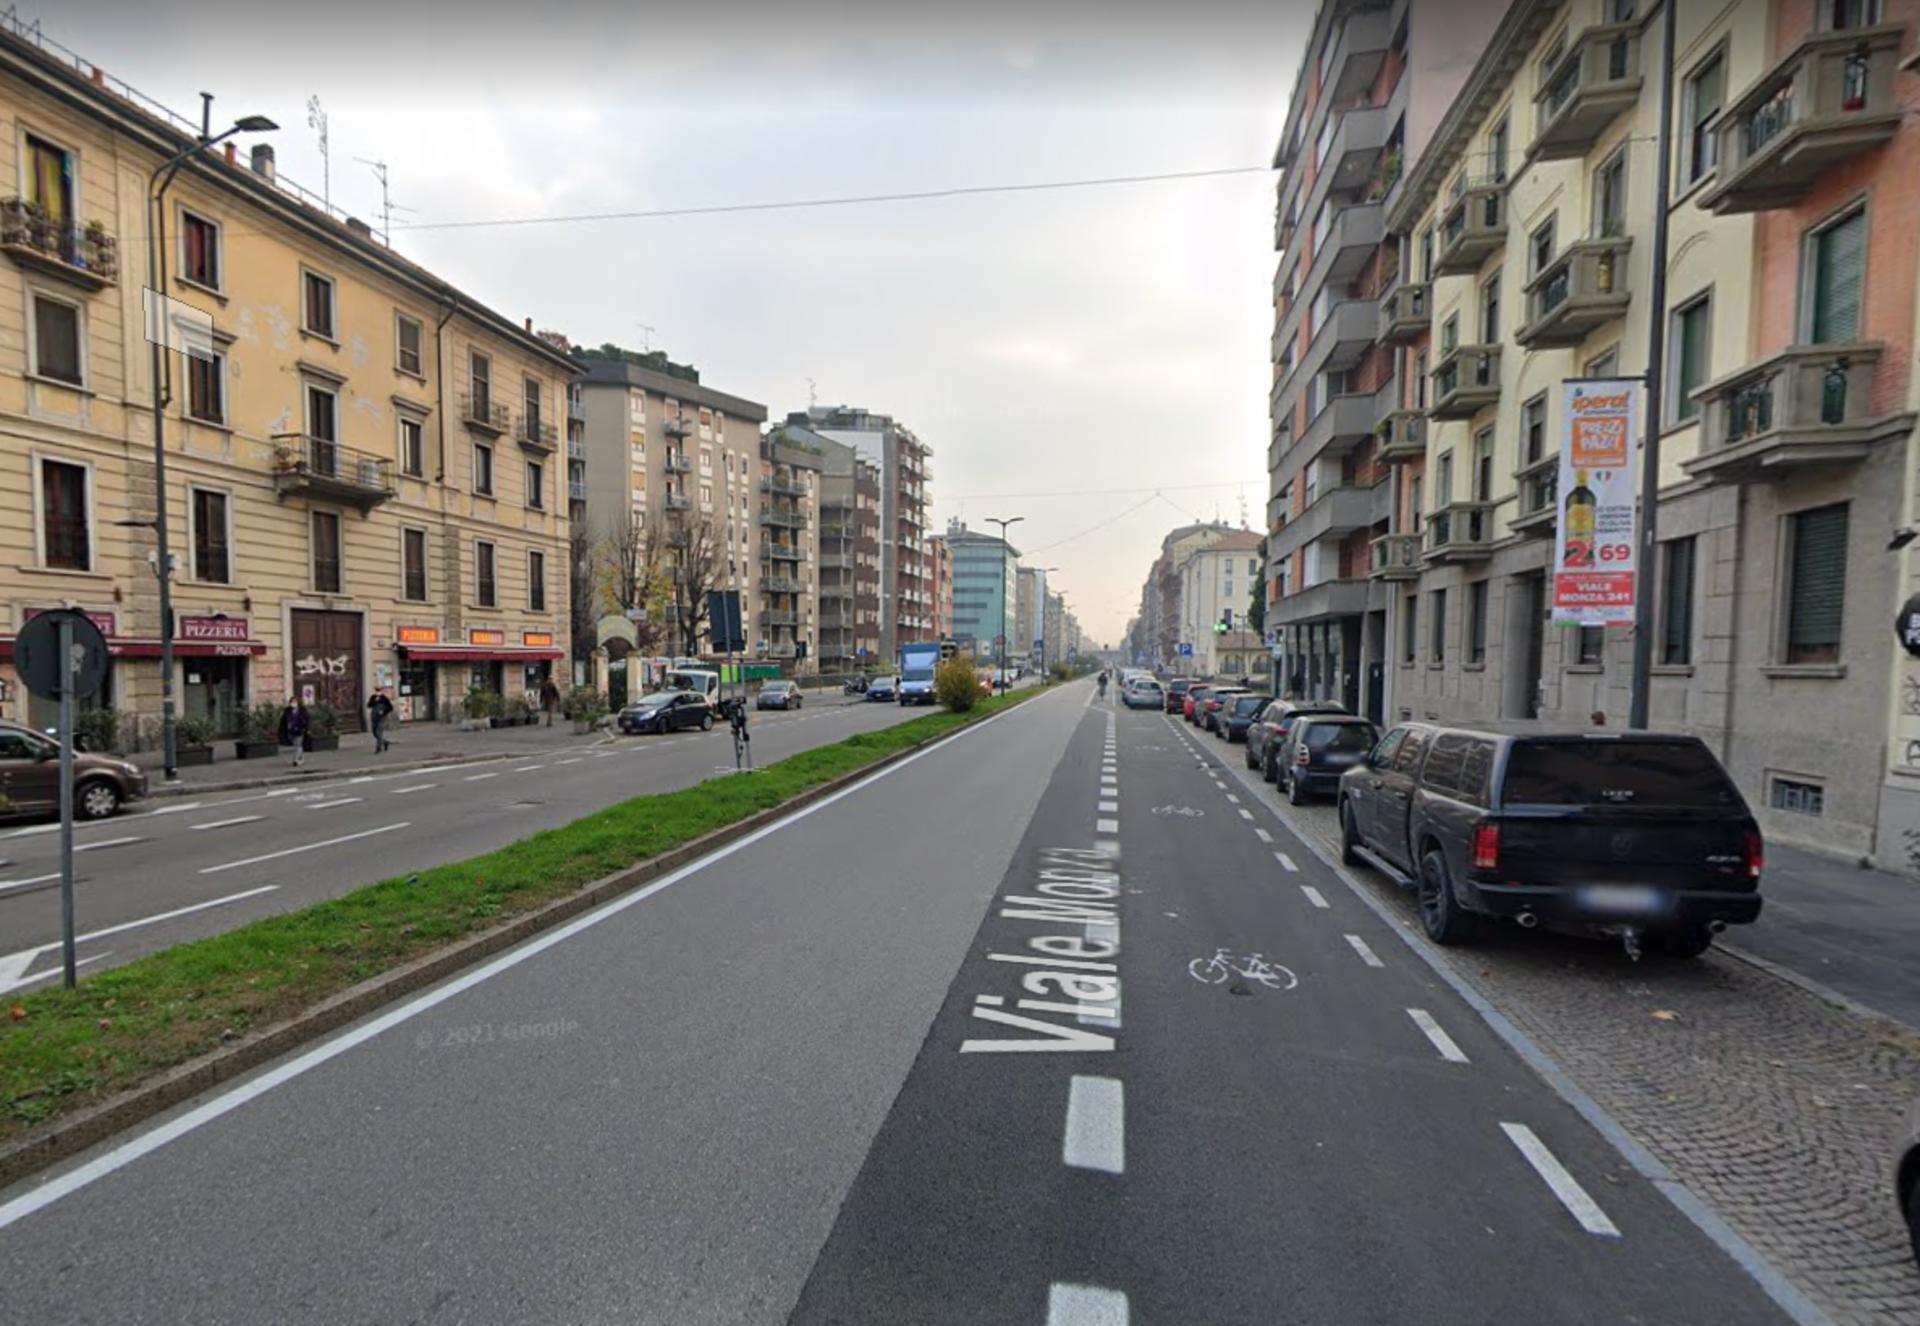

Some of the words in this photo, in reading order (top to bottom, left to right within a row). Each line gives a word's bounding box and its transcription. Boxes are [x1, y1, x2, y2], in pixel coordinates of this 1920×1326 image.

[1577, 582, 1613, 592] VIALE
[1559, 593, 1604, 602] MONZA
[184, 625, 247, 638] PIZZERIA
